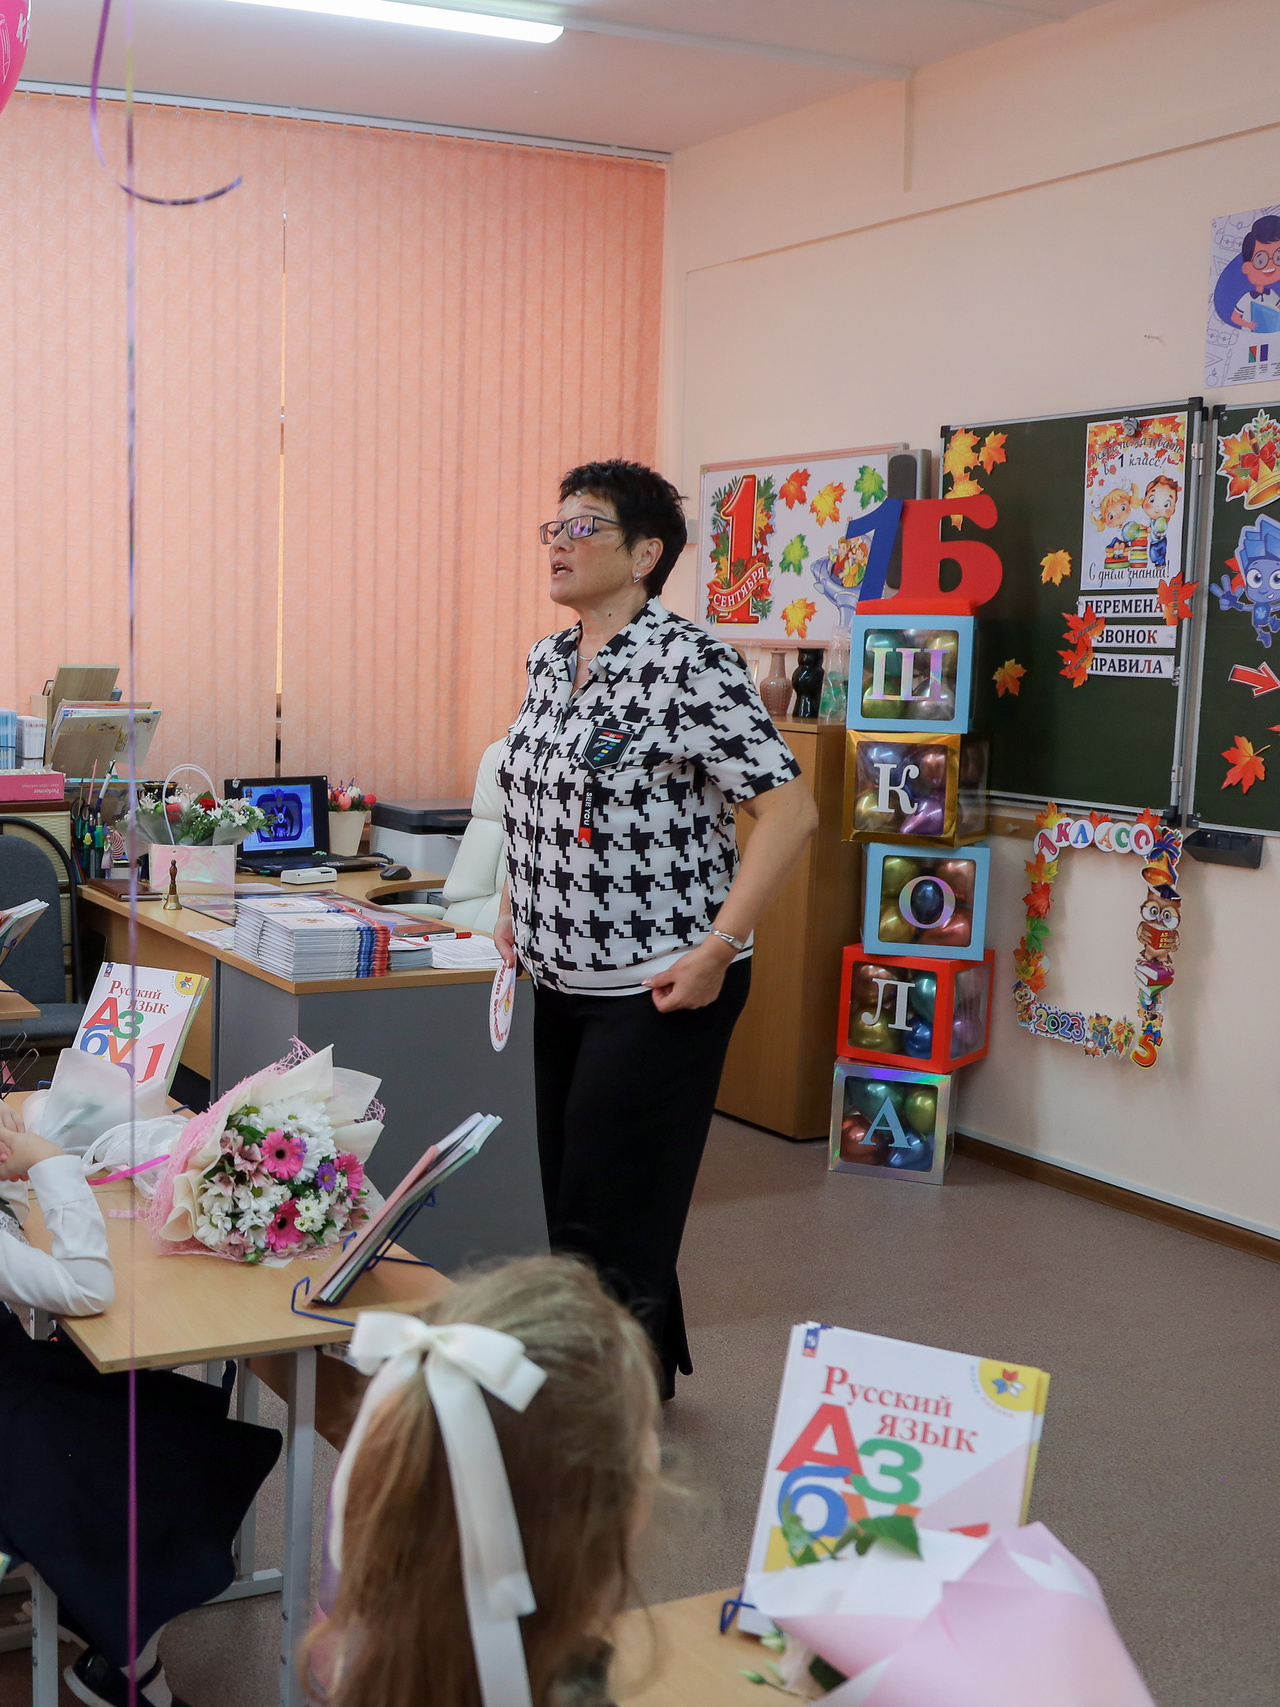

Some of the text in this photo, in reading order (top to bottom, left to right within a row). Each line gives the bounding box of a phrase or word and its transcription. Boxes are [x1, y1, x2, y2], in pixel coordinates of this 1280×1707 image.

[1118, 453, 1125, 468] 1
[715, 474, 760, 626] 1
[713, 566, 765, 608] СЕНТЯБРЯ
[1084, 599, 1164, 614] ПЕРЕМЕНА
[1096, 630, 1158, 644] ЗВОНОК
[1090, 658, 1163, 674] ПРАВИЛА
[583, 808, 591, 826] YOU
[1034, 1007, 1085, 1042] 2023
[137, 1043, 165, 1084] 1
[821, 1365, 953, 1418] Русский
